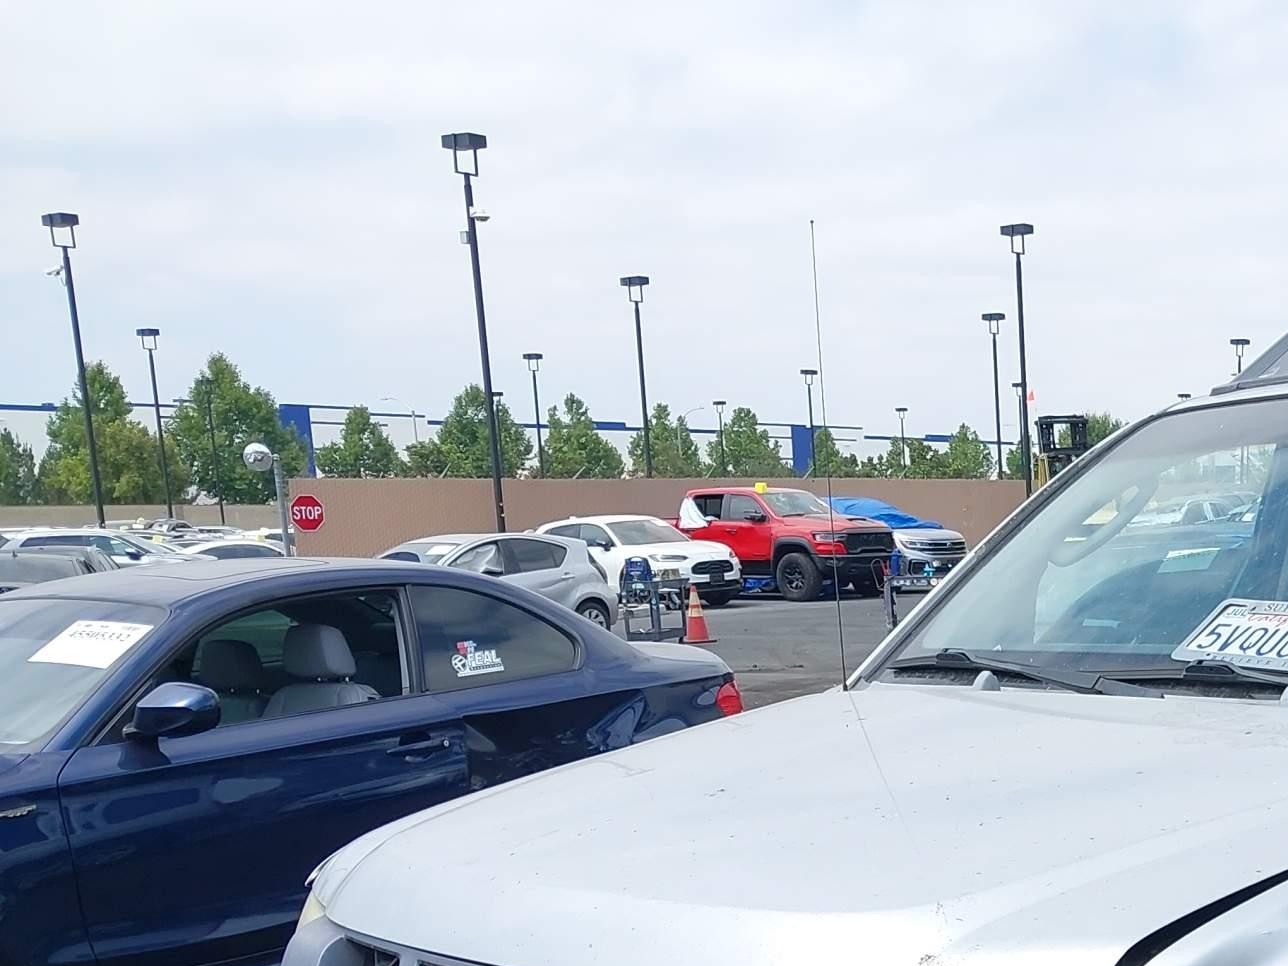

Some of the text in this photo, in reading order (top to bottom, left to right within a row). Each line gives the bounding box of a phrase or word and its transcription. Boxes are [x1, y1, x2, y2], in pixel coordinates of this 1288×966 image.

[293, 506, 322, 520] STOP
[1227, 608, 1247, 617] JUL
[467, 650, 501, 667] FEAL
